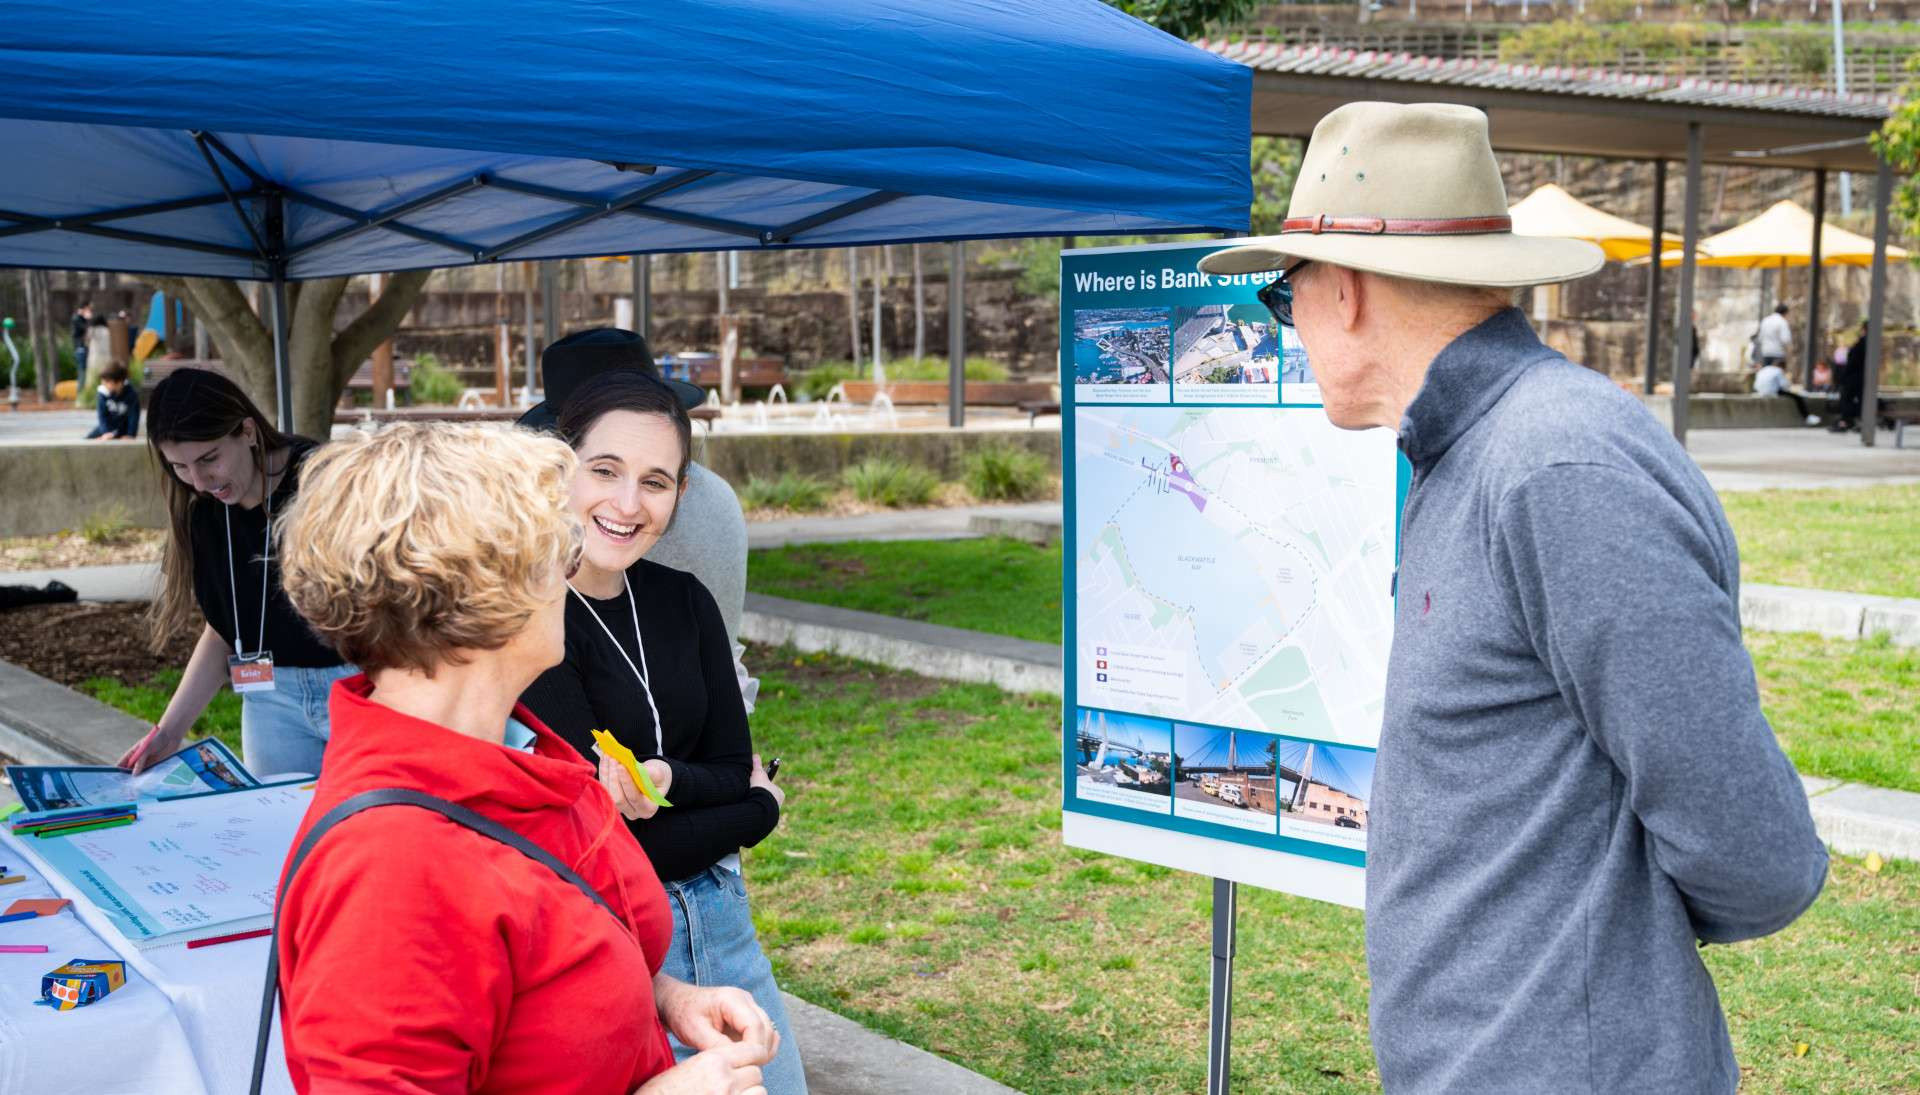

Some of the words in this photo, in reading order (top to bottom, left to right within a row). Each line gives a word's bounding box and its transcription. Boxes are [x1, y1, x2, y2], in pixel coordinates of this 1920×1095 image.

[1074, 272, 1136, 292] Where
[1140, 269, 1156, 289] is
[1161, 268, 1212, 289] Bank
